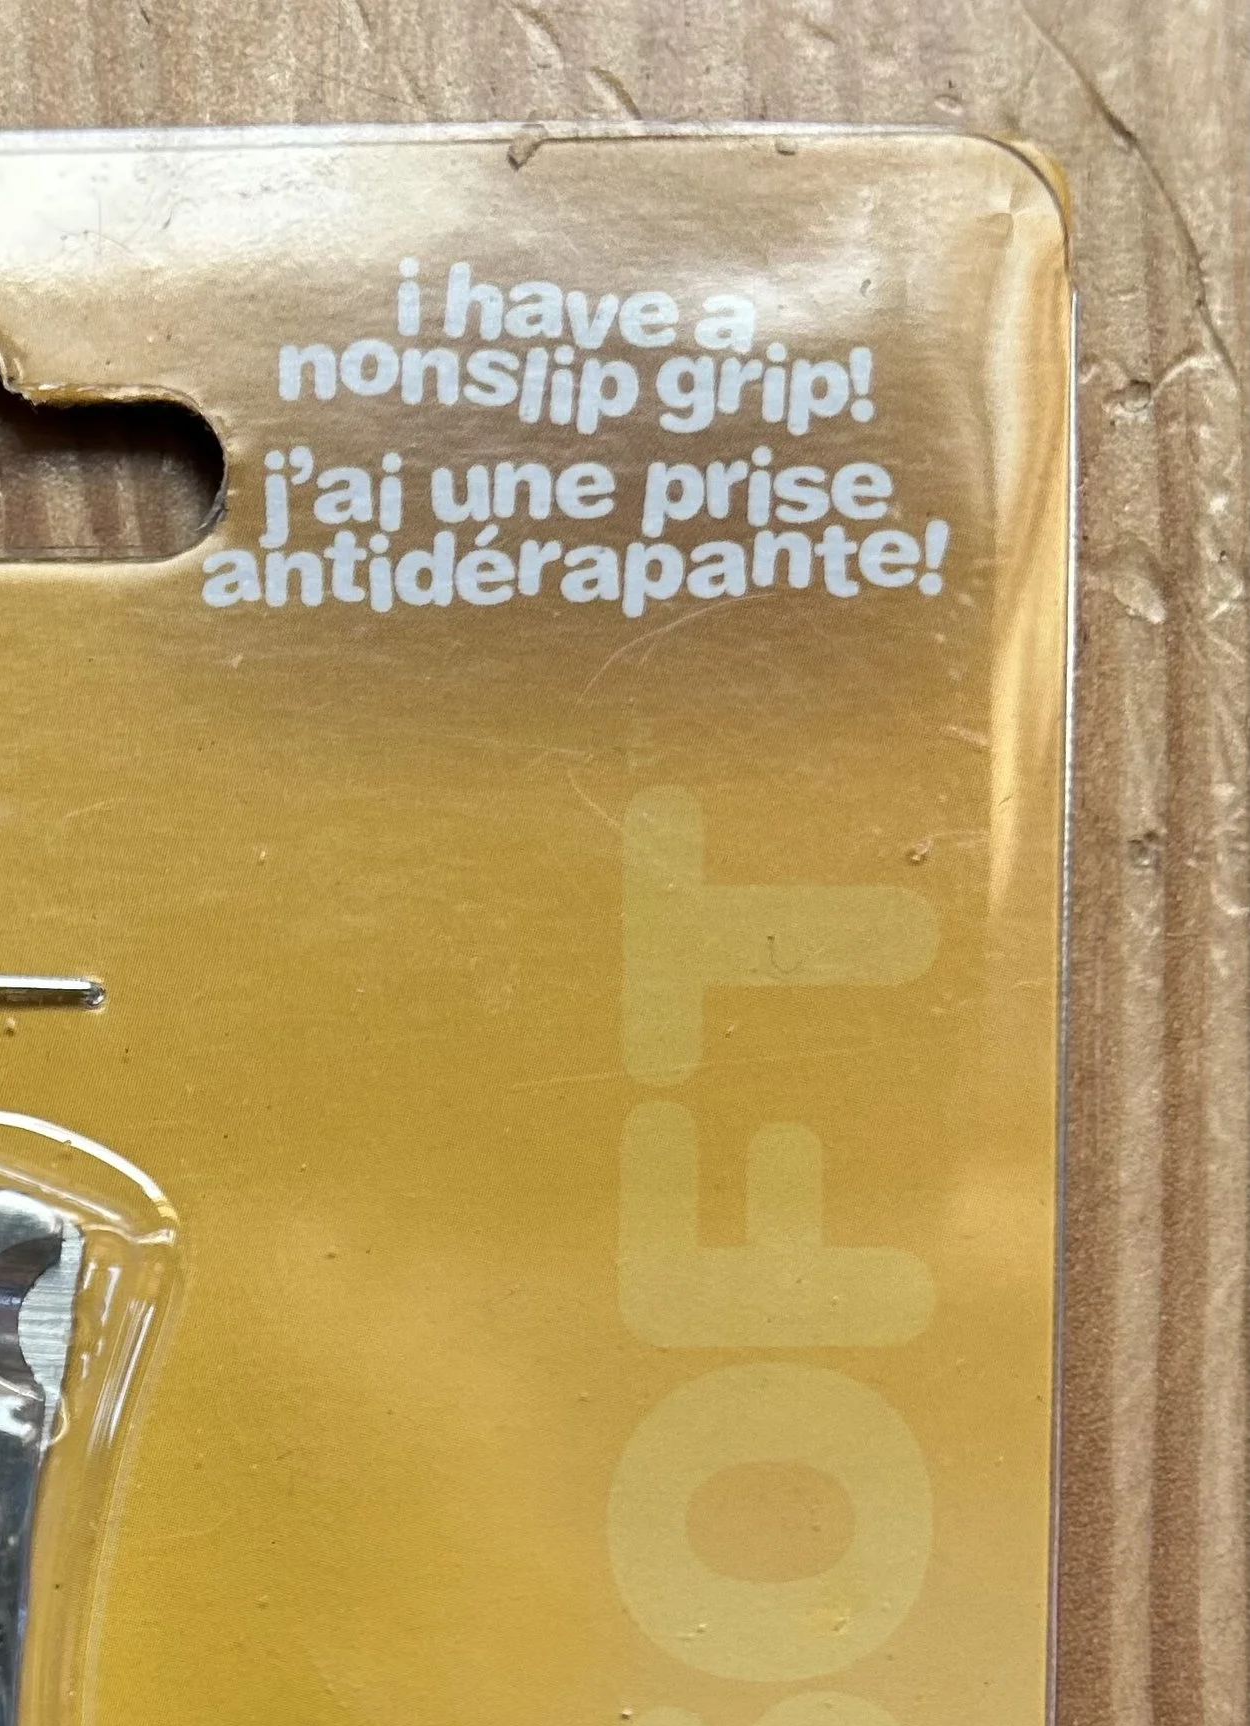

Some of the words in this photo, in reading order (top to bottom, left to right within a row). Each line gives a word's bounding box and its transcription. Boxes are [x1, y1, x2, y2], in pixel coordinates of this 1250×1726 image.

[398, 257, 420, 336] i
[444, 262, 678, 350] have
[694, 294, 755, 352] a
[278, 337, 638, 434] nonslip
[657, 345, 874, 434] grip!
[431, 462, 616, 522] une
[642, 447, 893, 537] prise
[202, 520, 948, 617] antidérapante!
